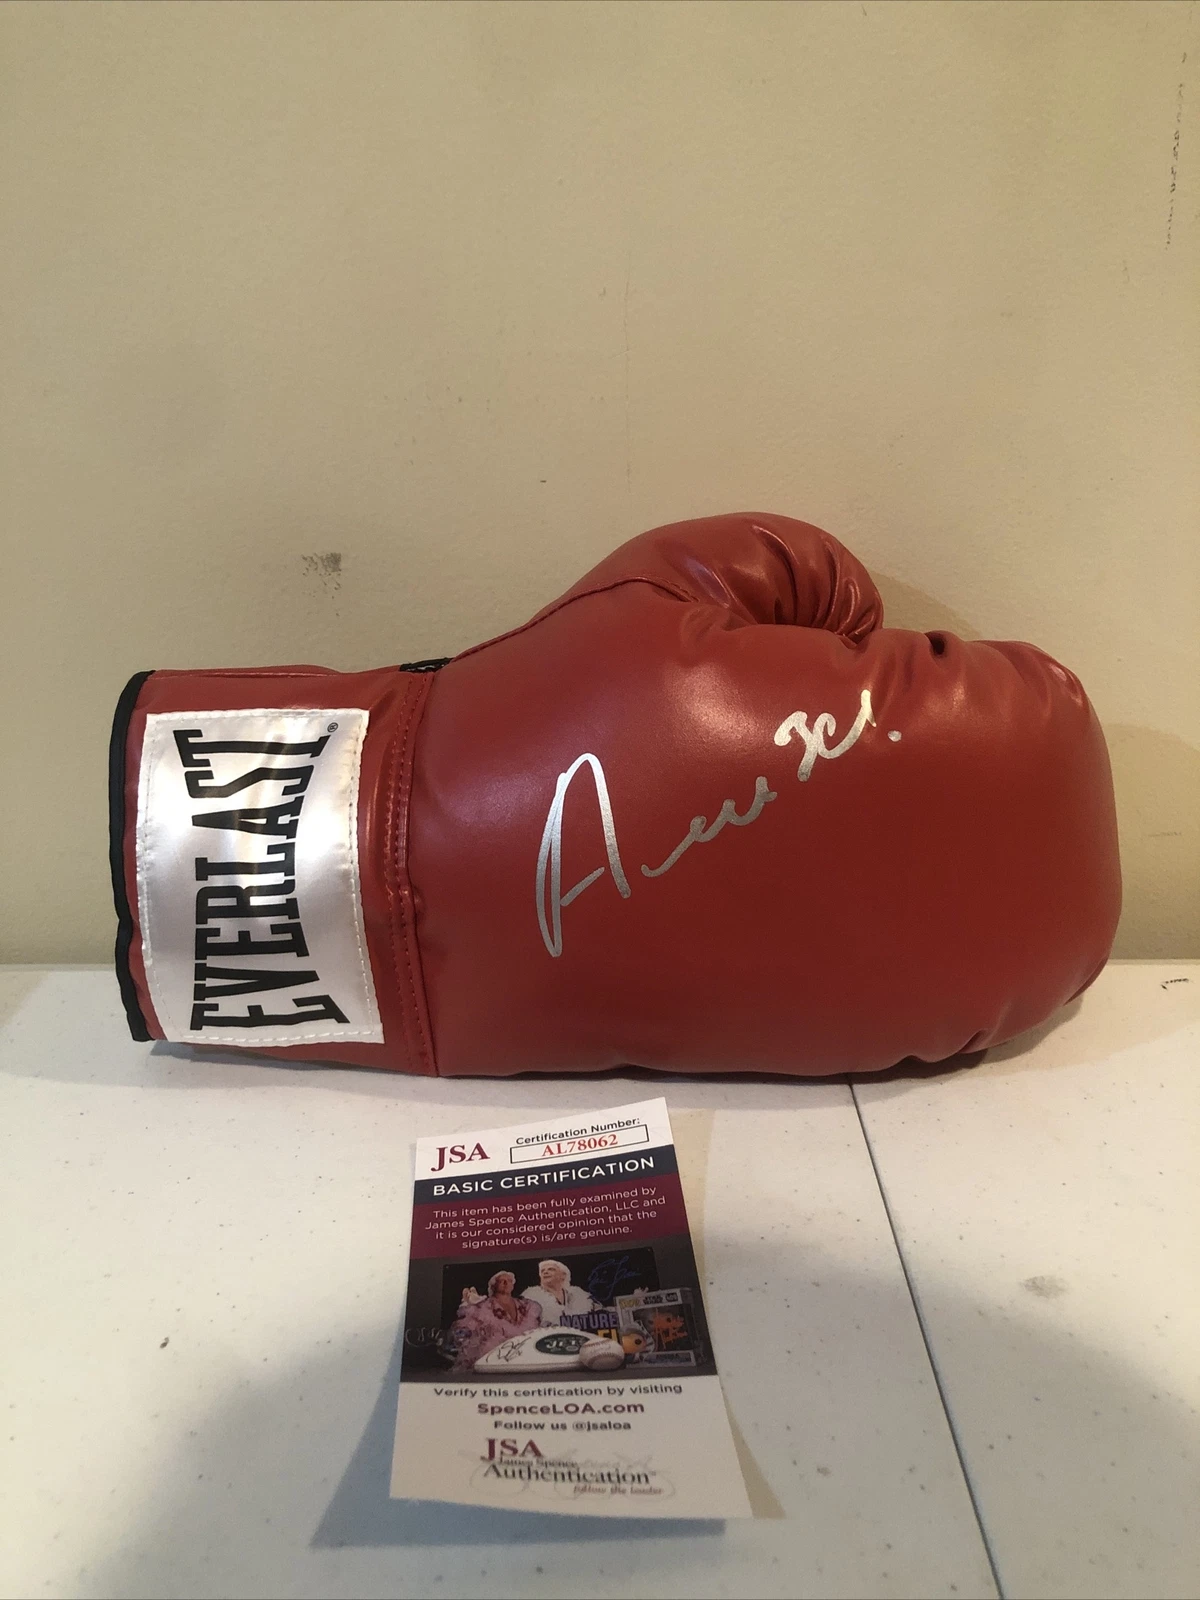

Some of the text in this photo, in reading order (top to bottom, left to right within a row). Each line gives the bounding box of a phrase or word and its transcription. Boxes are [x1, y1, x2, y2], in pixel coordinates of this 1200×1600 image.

[516, 1117, 641, 1145] Certification Number:
[430, 1142, 491, 1172] JSA
[542, 1133, 619, 1157] AL78062
[433, 1155, 655, 1197] BASIC CERTIFICATION
[425, 1195, 666, 1231] James Spence Authentication, LLC and
[433, 1186, 657, 1219] This item has been fully examined by
[435, 1209, 657, 1240] it is our considered opinion that the
[462, 1225, 633, 1250] signature(s) is/are genuine.
[433, 1383, 683, 1399] Verify this certification by visiting
[477, 1402, 645, 1416] SpenceLOA.com
[494, 1420, 632, 1433] Follow us @jsaloa
[480, 1437, 544, 1463] JSA
